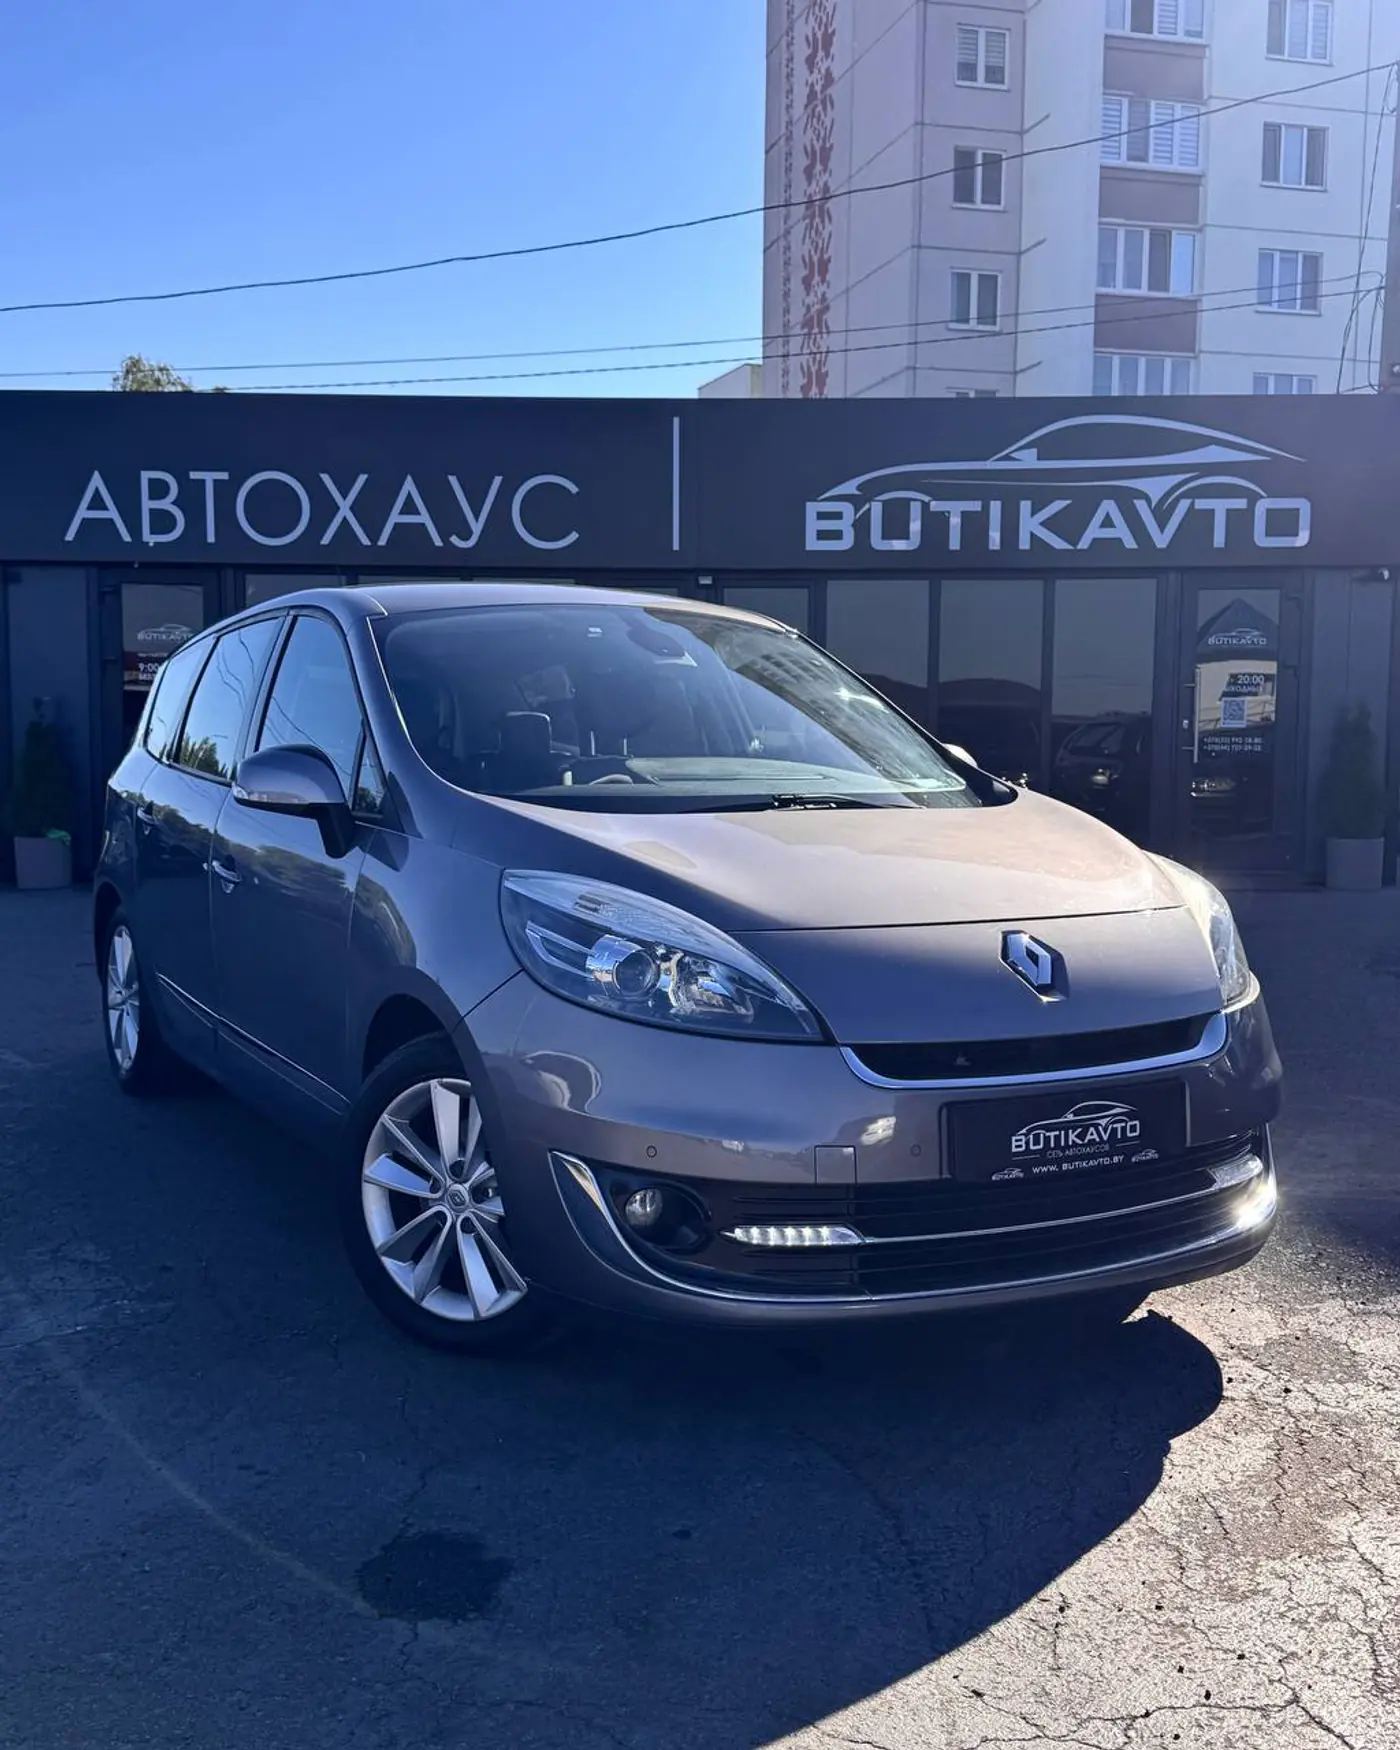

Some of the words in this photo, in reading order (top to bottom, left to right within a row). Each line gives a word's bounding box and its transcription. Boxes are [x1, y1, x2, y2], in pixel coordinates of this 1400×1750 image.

[64, 470, 581, 551] АВТОХАУС
[805, 496, 1312, 551] BUTIKAVTO
[1011, 1120, 1140, 1152] BUTIKAVTO
